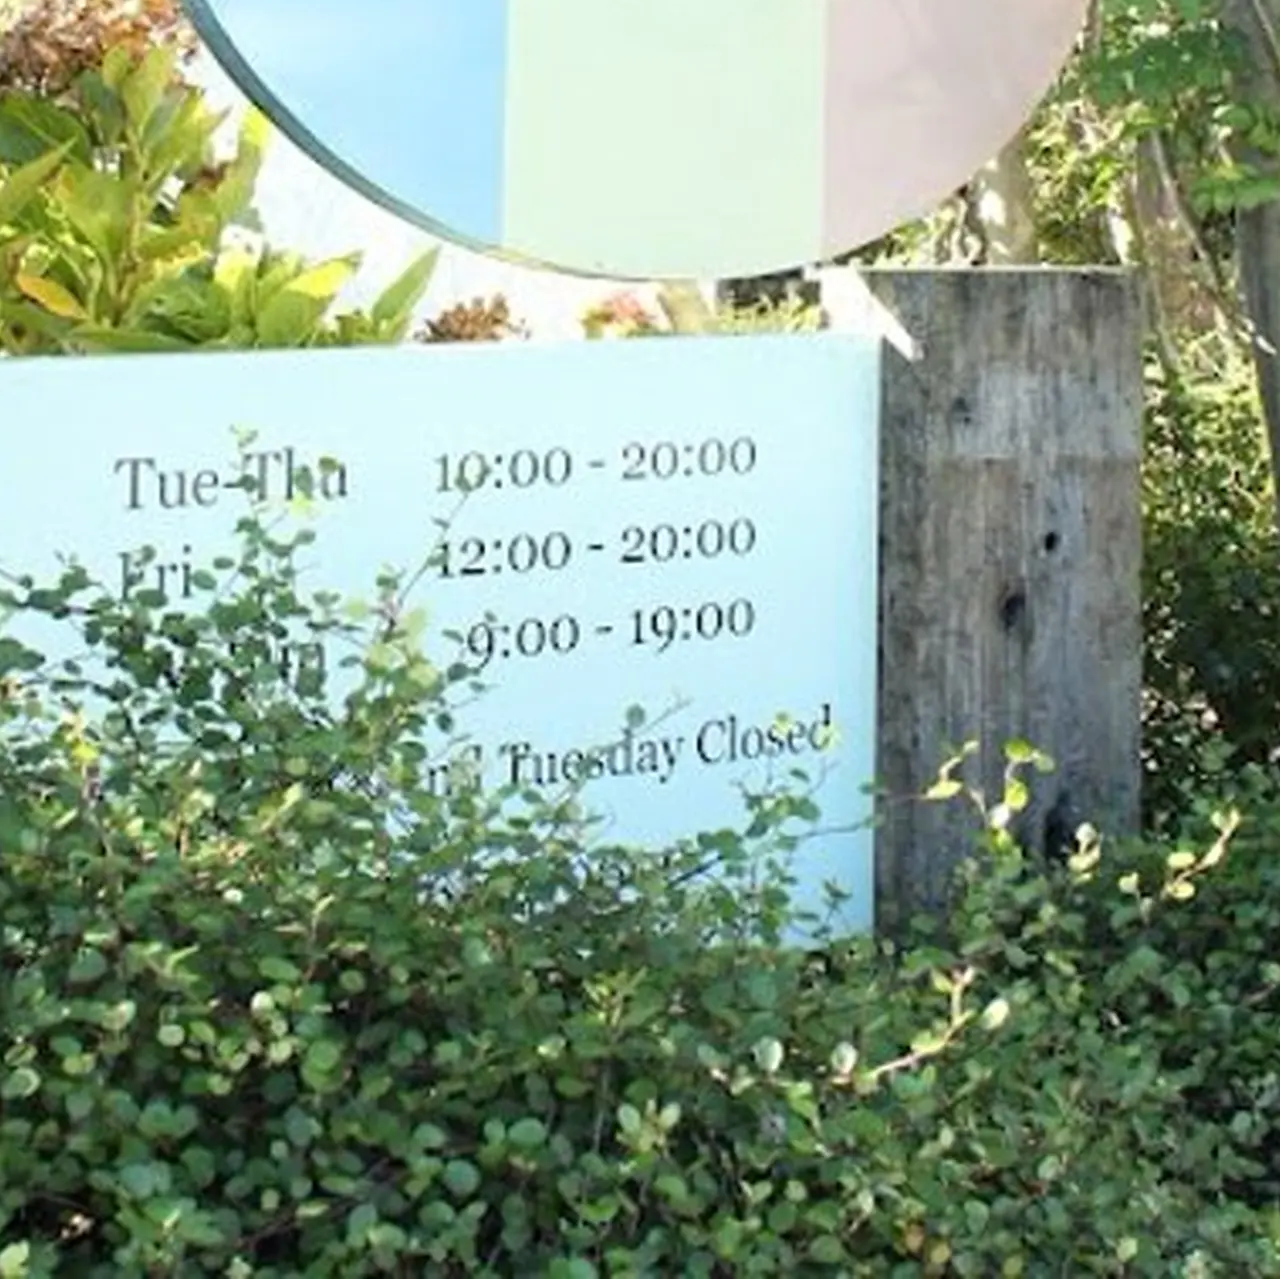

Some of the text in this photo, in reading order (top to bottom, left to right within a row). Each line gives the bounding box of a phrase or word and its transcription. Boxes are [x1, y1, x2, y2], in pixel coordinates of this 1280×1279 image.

[434, 447, 572, 493] 10:00
[621, 436, 757, 481] 20:00
[436, 531, 572, 579] 12:00
[620, 518, 757, 563] 20:00
[467, 614, 581, 673] 9:00
[632, 598, 757, 653] 19:00
[499, 728, 685, 785] Tuesday
[696, 704, 832, 764] Closed
